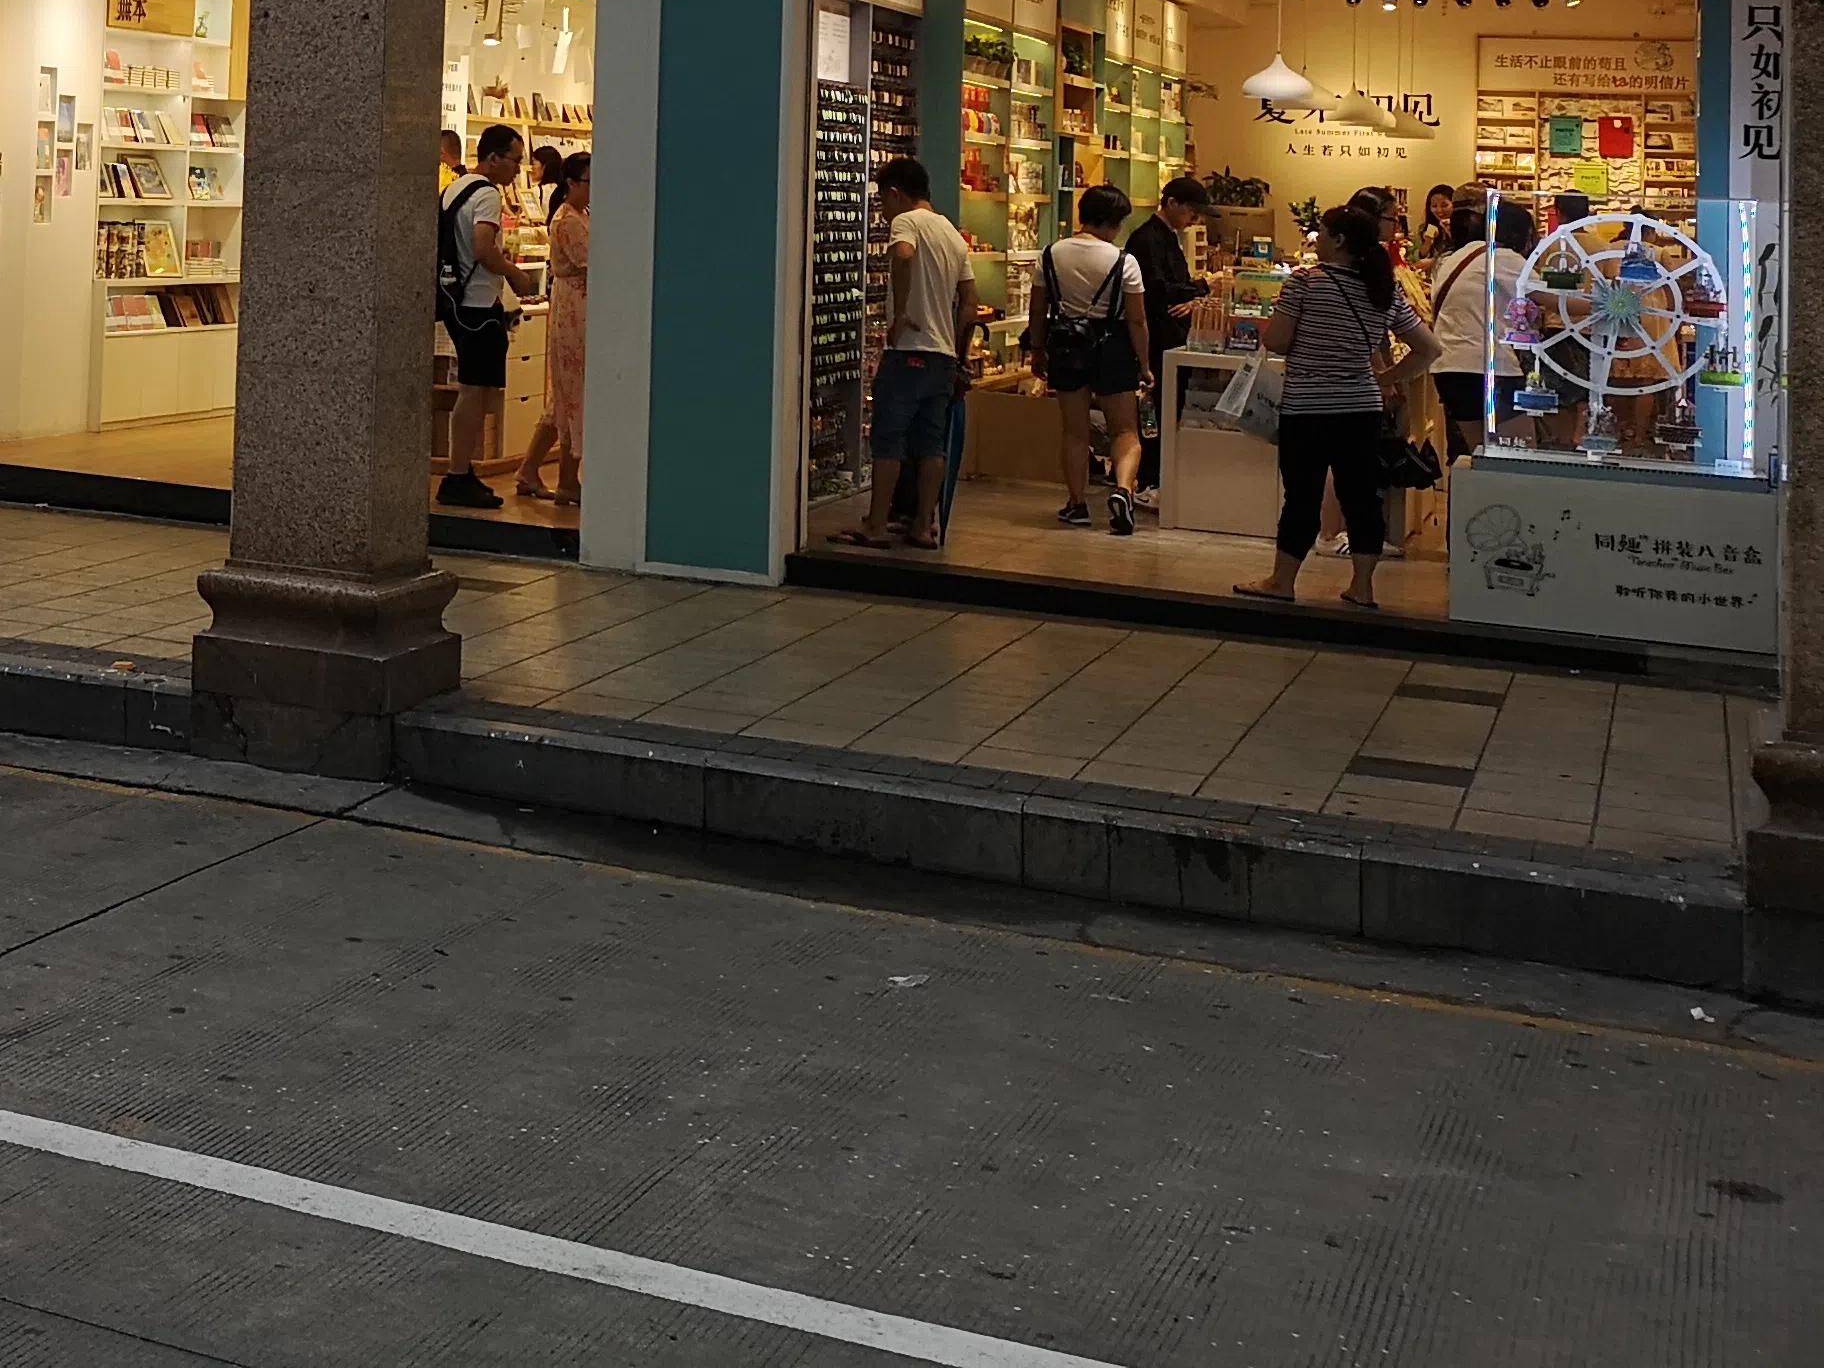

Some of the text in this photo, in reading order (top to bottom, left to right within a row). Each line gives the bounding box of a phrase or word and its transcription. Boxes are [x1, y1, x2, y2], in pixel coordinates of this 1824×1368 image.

[1285, 143, 1408, 159] 人生若只如初见
